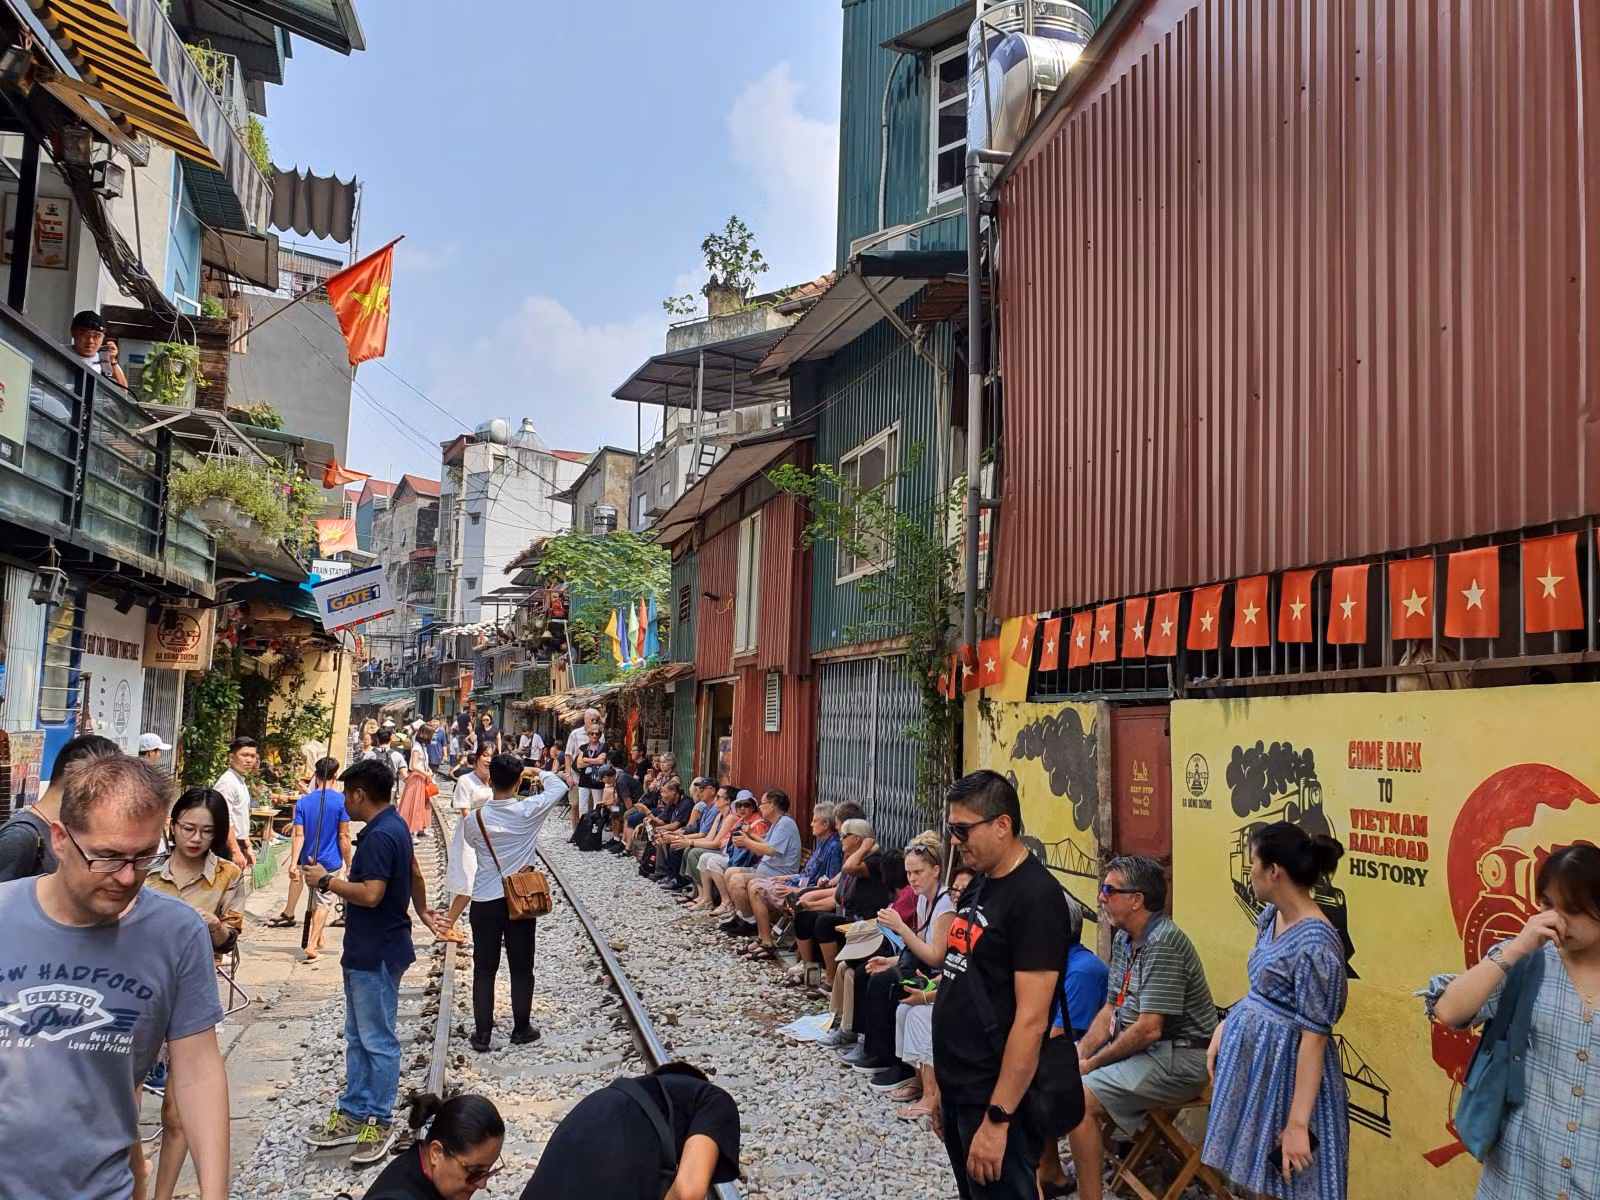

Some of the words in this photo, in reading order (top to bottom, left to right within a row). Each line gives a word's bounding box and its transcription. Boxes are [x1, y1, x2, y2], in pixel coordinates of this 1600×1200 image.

[313, 566, 328, 575] TRAIN
[331, 588, 370, 609] GATE
[371, 586, 380, 599] 1
[1348, 740, 1384, 770] COME
[1386, 741, 1422, 773] BACK
[1378, 777, 1393, 804] TO
[1350, 808, 1429, 838] VIETNAM
[1349, 832, 1429, 863] RAILROAD
[1350, 858, 1429, 888] HISTORY
[38, 962, 154, 1000] HADFORD
[27, 991, 94, 1007] CLASSIC
[20, 1003, 85, 1037] Pub
[68, 1040, 99, 1051] Lowest
[103, 1043, 131, 1055] Prices
[90, 1031, 111, 1042] Best
